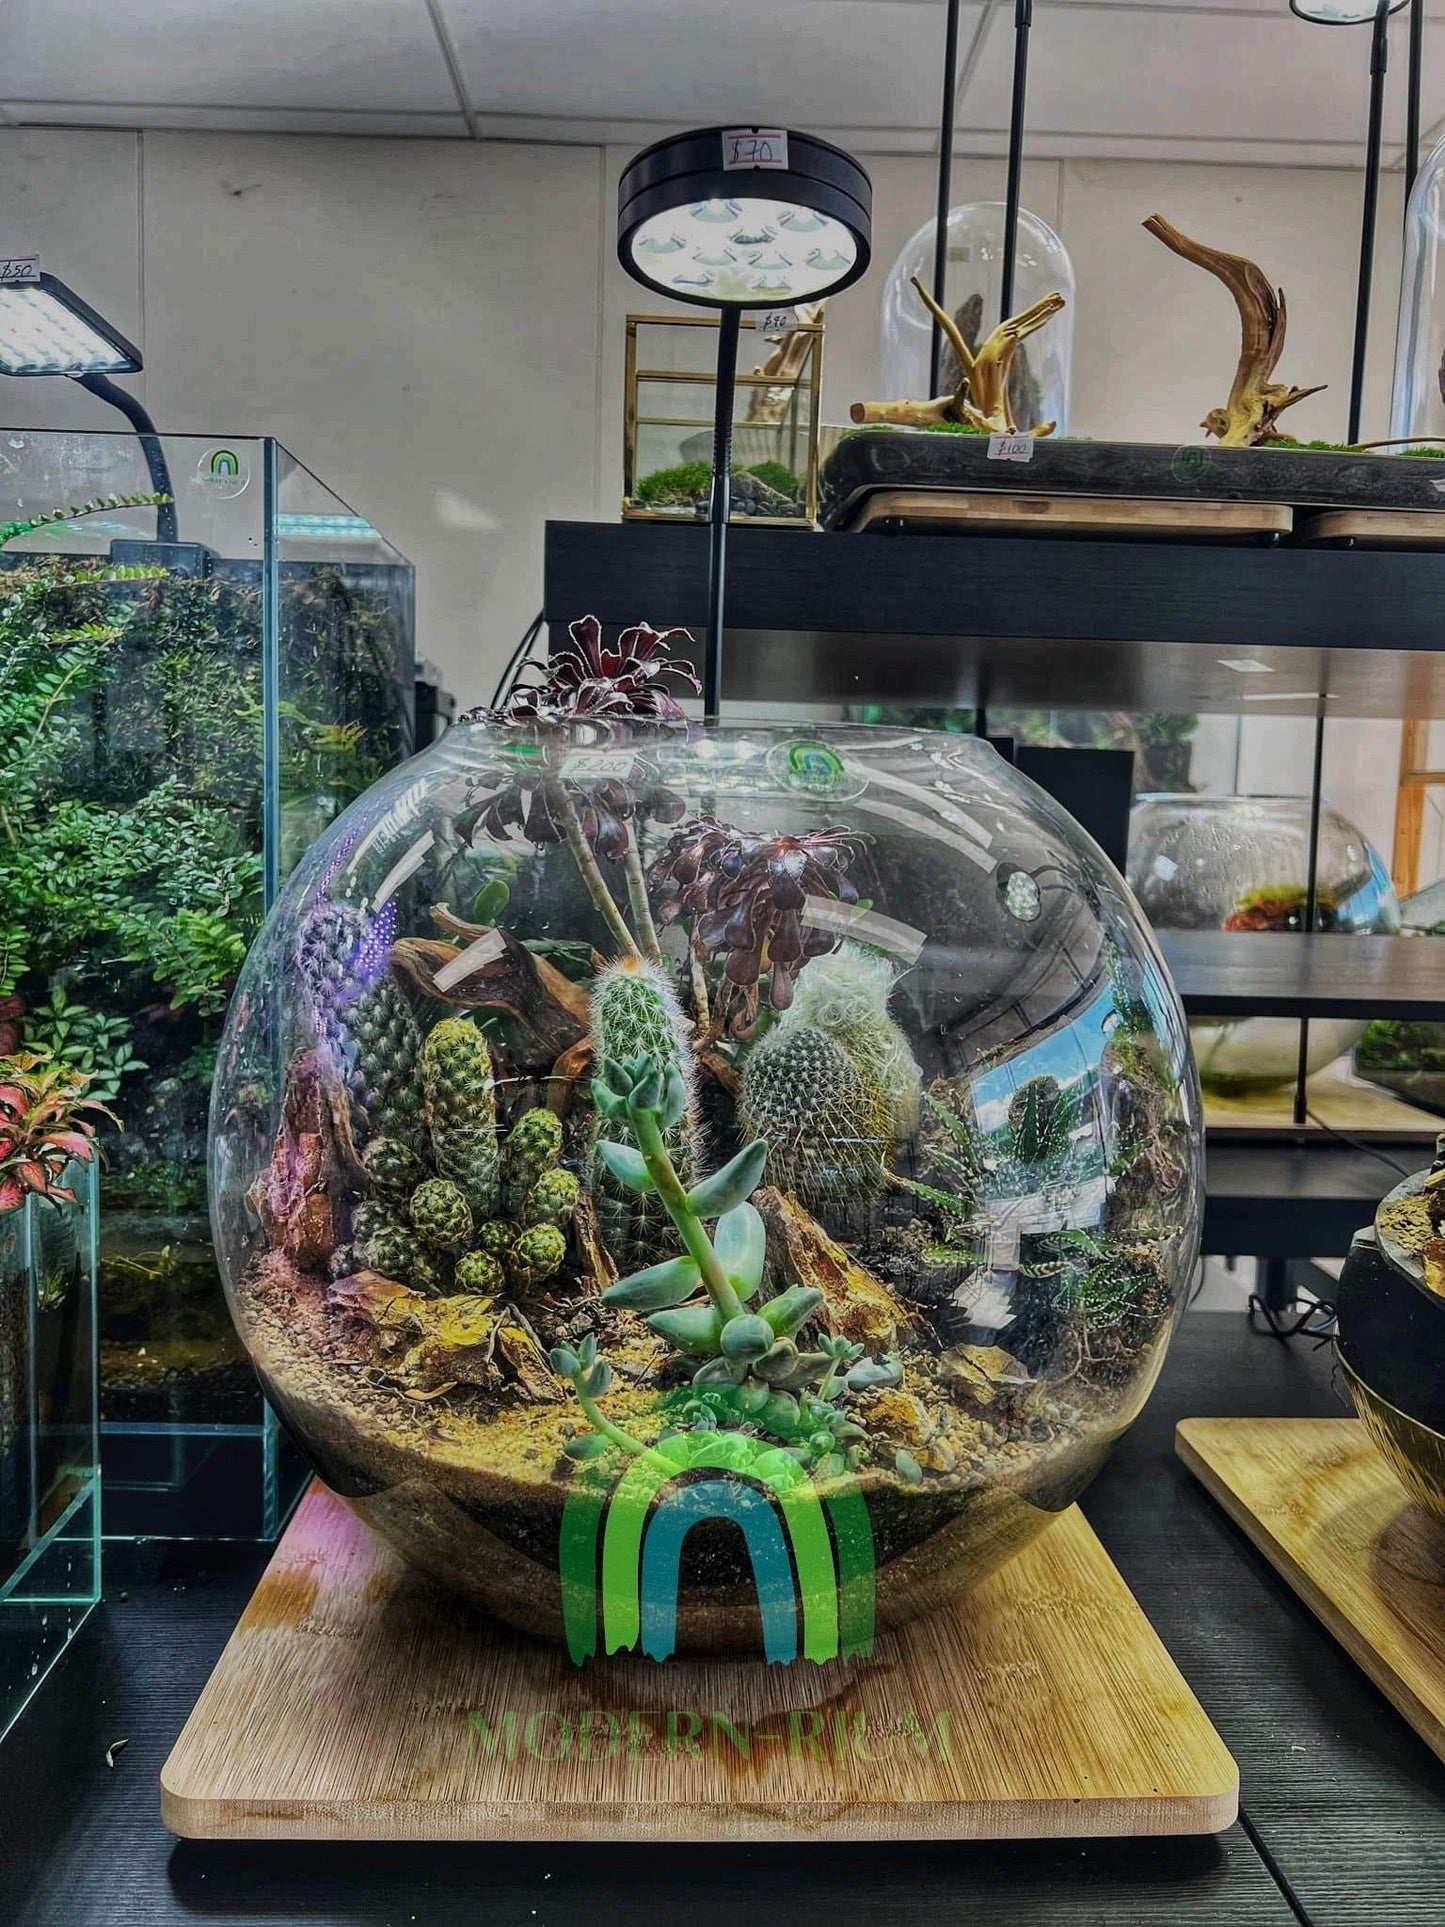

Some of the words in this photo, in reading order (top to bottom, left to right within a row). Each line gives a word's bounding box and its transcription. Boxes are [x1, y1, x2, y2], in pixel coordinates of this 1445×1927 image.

[730, 138, 773, 164] $70
[0, 261, 34, 281] $50
[998, 438, 1028, 456] $100
